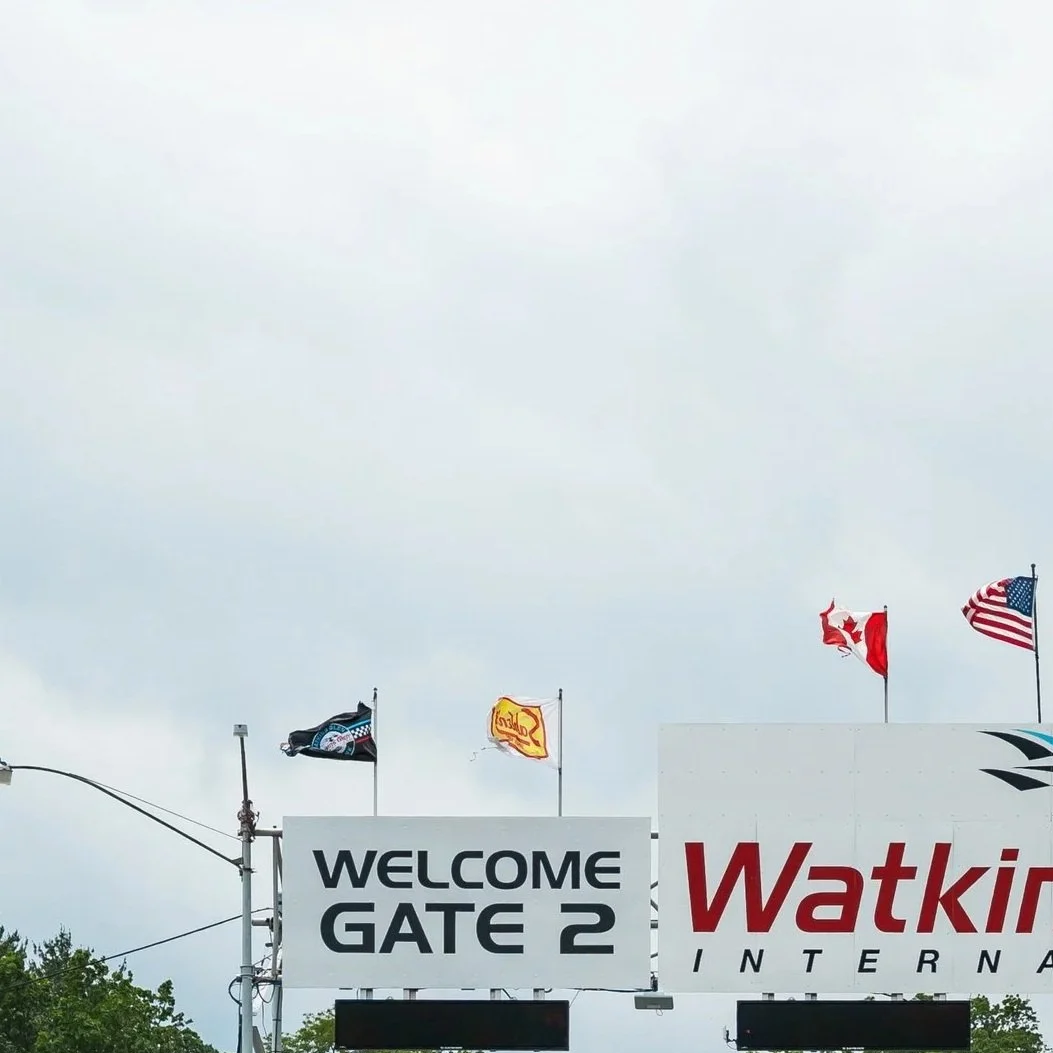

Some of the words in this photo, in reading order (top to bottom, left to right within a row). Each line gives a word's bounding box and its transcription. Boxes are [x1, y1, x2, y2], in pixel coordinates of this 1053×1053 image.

[313, 850, 621, 890] WELCOME
[320, 903, 524, 954] GATE
[560, 903, 615, 954] 2
